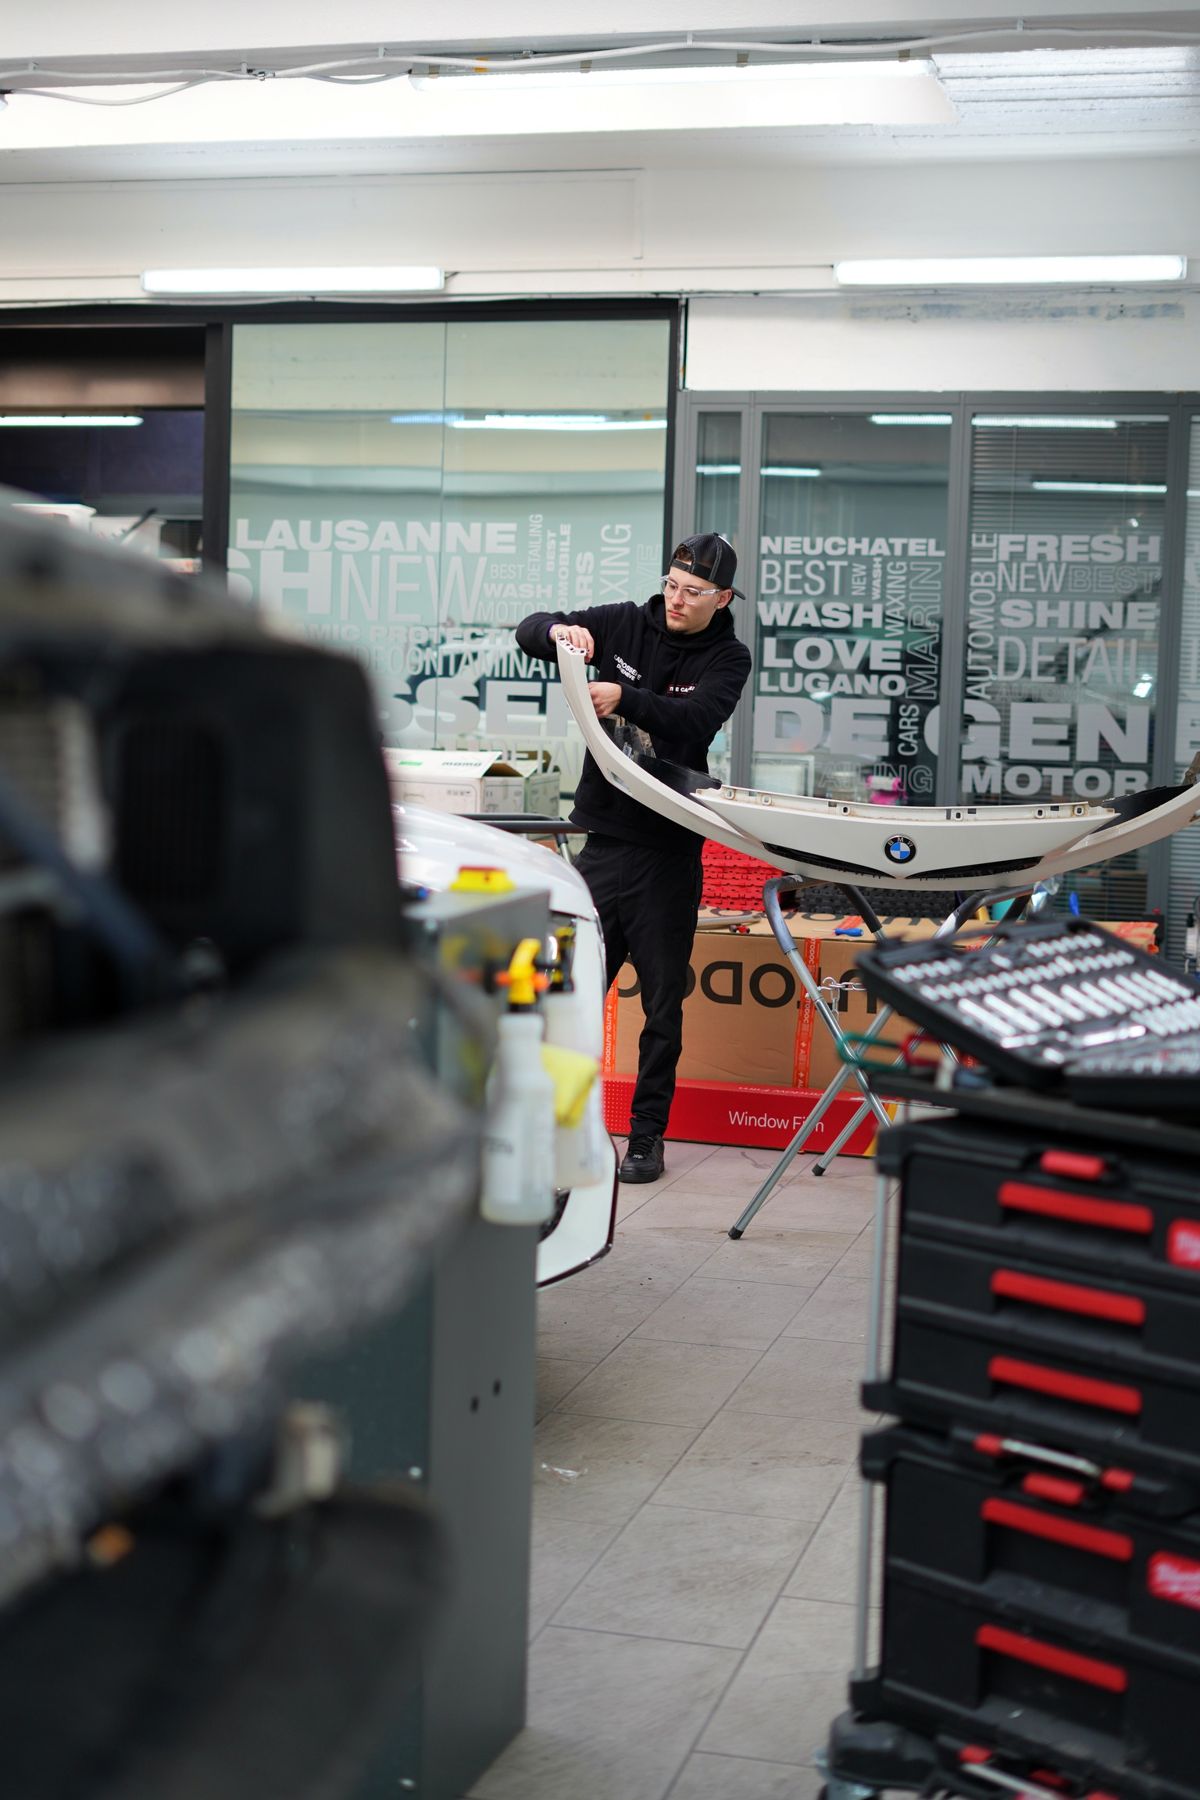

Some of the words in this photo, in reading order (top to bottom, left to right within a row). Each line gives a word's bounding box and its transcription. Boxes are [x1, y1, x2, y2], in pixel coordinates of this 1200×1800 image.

[236, 518, 517, 554] LAUSANNE
[527, 514, 543, 582] DETAILING
[546, 529, 557, 571] BEST
[760, 536, 945, 557] NEUCHATEL
[999, 534, 1161, 563] FRESH
[340, 553, 487, 623] NEW
[490, 564, 525, 580] BEST
[760, 560, 848, 596] BEST
[851, 563, 867, 596] NEW
[872, 557, 883, 600] WASH
[997, 562, 1066, 593] NEW
[1068, 565, 1161, 594] BEST
[483, 582, 552, 599] WASH
[885, 561, 907, 638] WAXING
[757, 601, 882, 628] WASH
[905, 561, 942, 700] MARIN
[967, 533, 997, 700] AUTOMOBILE
[1000, 598, 1159, 630] SHINE
[303, 624, 361, 641] MIC
[763, 637, 902, 671] LOVE
[998, 636, 1148, 685] DETAIL
[759, 672, 906, 696] LUGANO
[754, 696, 891, 756] DE
[898, 704, 919, 756] CARS
[961, 764, 1149, 798] MOTOR
[728, 1110, 790, 1130] Window
[793, 1115, 825, 1133] Fim
